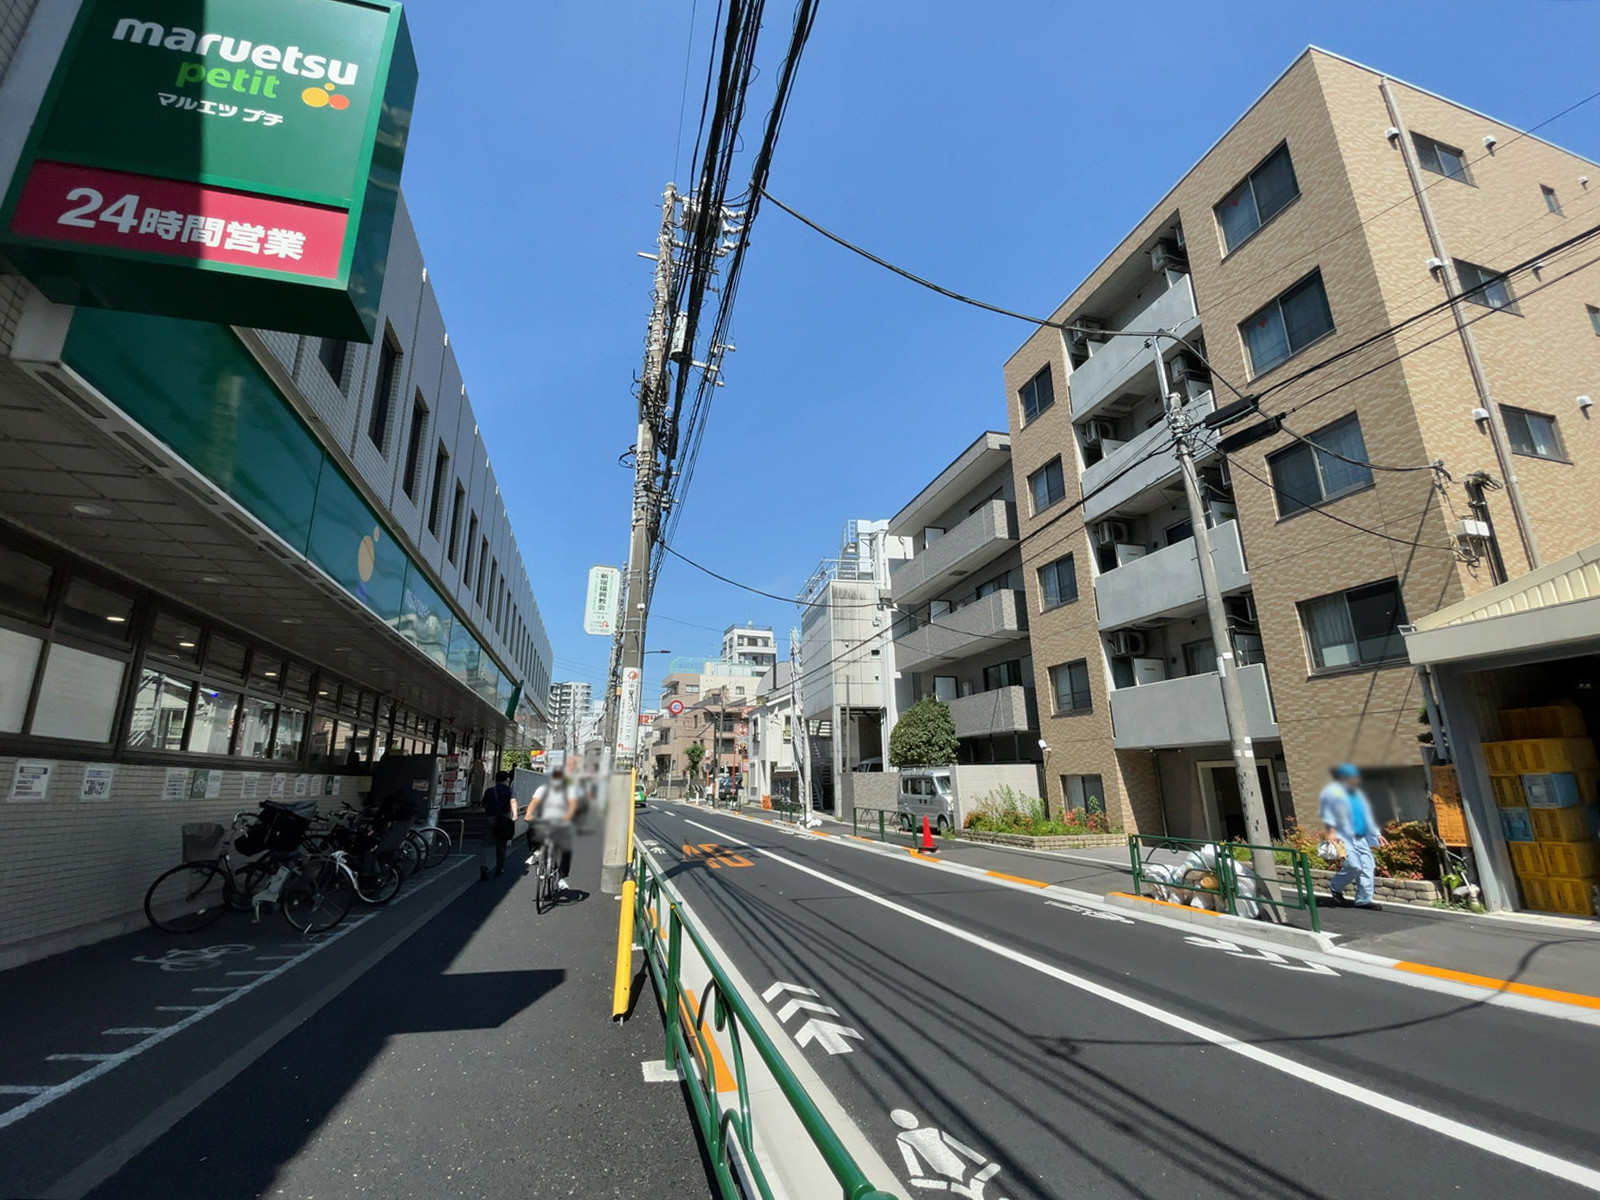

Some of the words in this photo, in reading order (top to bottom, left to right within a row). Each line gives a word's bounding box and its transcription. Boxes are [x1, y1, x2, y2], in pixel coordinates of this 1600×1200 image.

[112, 17, 359, 86] maruetsu
[176, 61, 281, 99] petit
[157, 92, 238, 118] マルエツ
[243, 107, 283, 127] プチ
[57, 187, 307, 261] 24時間営業
